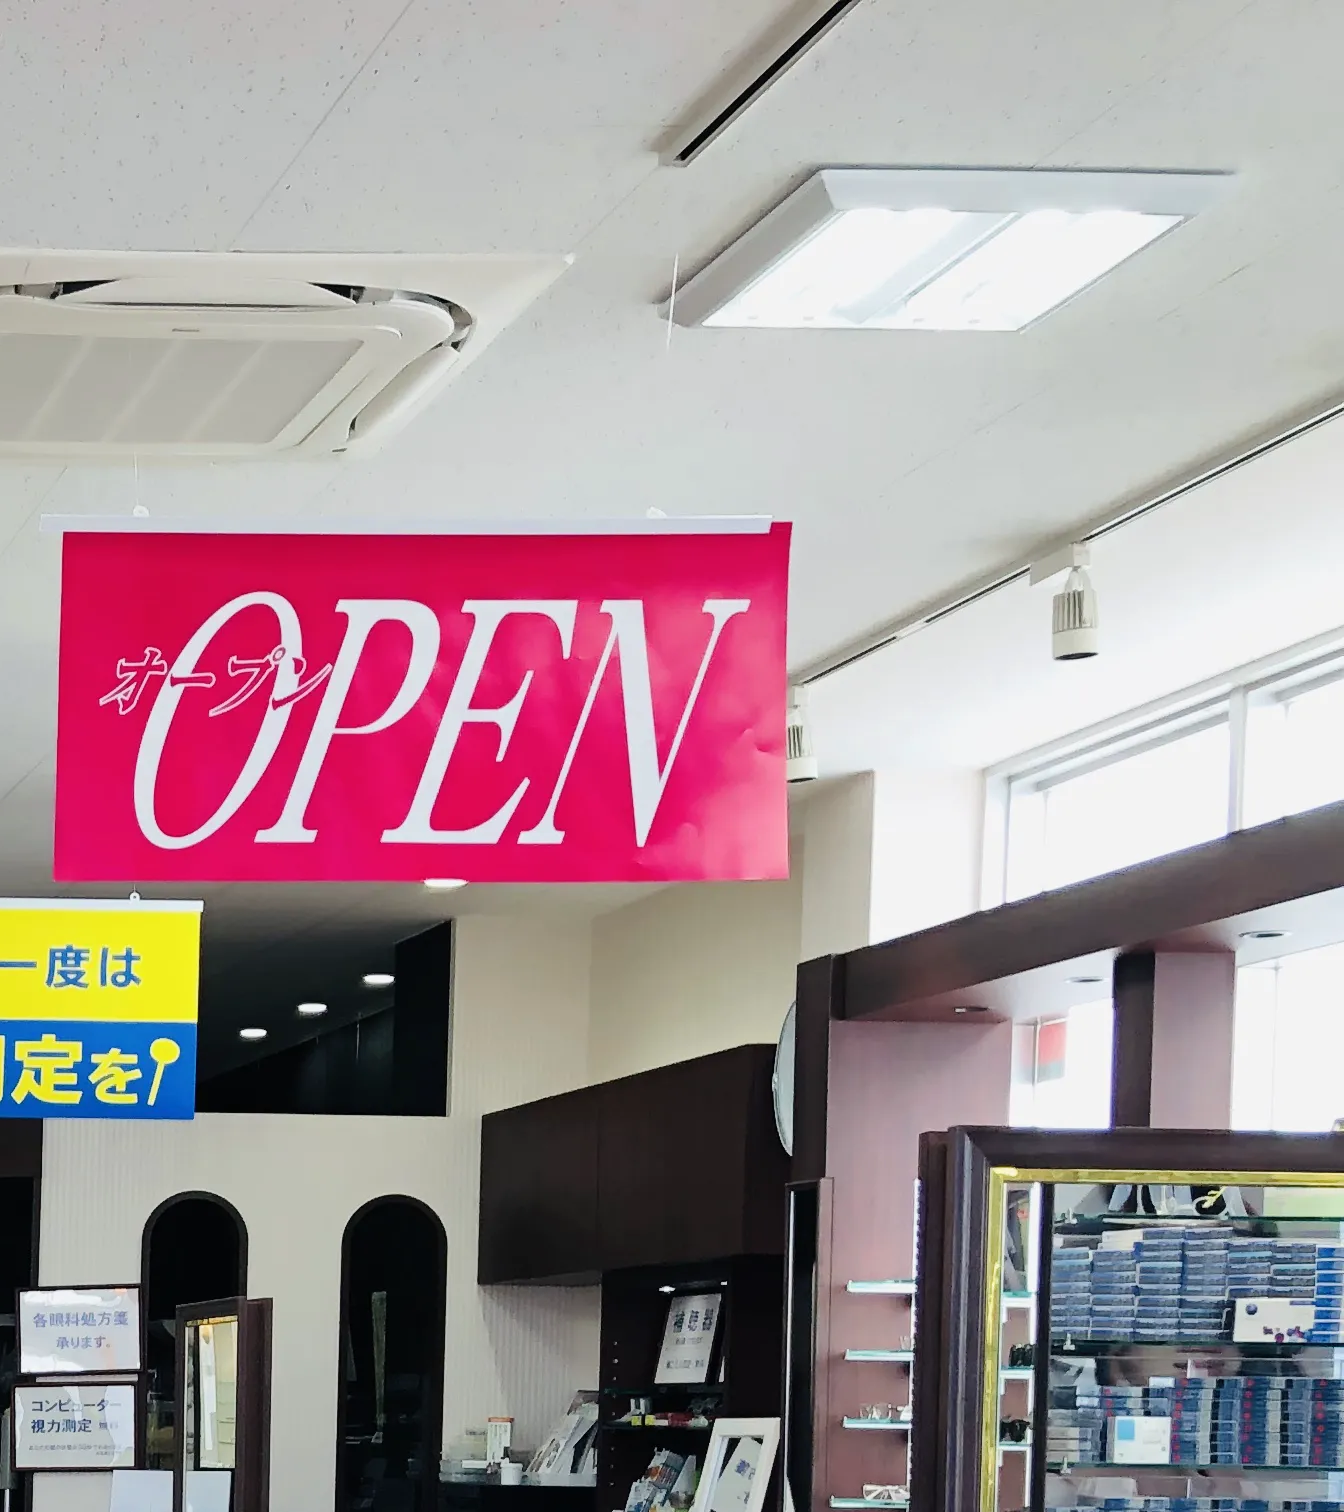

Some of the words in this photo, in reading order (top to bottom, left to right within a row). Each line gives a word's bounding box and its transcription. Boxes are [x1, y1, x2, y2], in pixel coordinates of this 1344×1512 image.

[99, 646, 334, 717] オープン
[133, 591, 750, 850] OPEN
[31, 1419, 92, 1434] 視力測定
